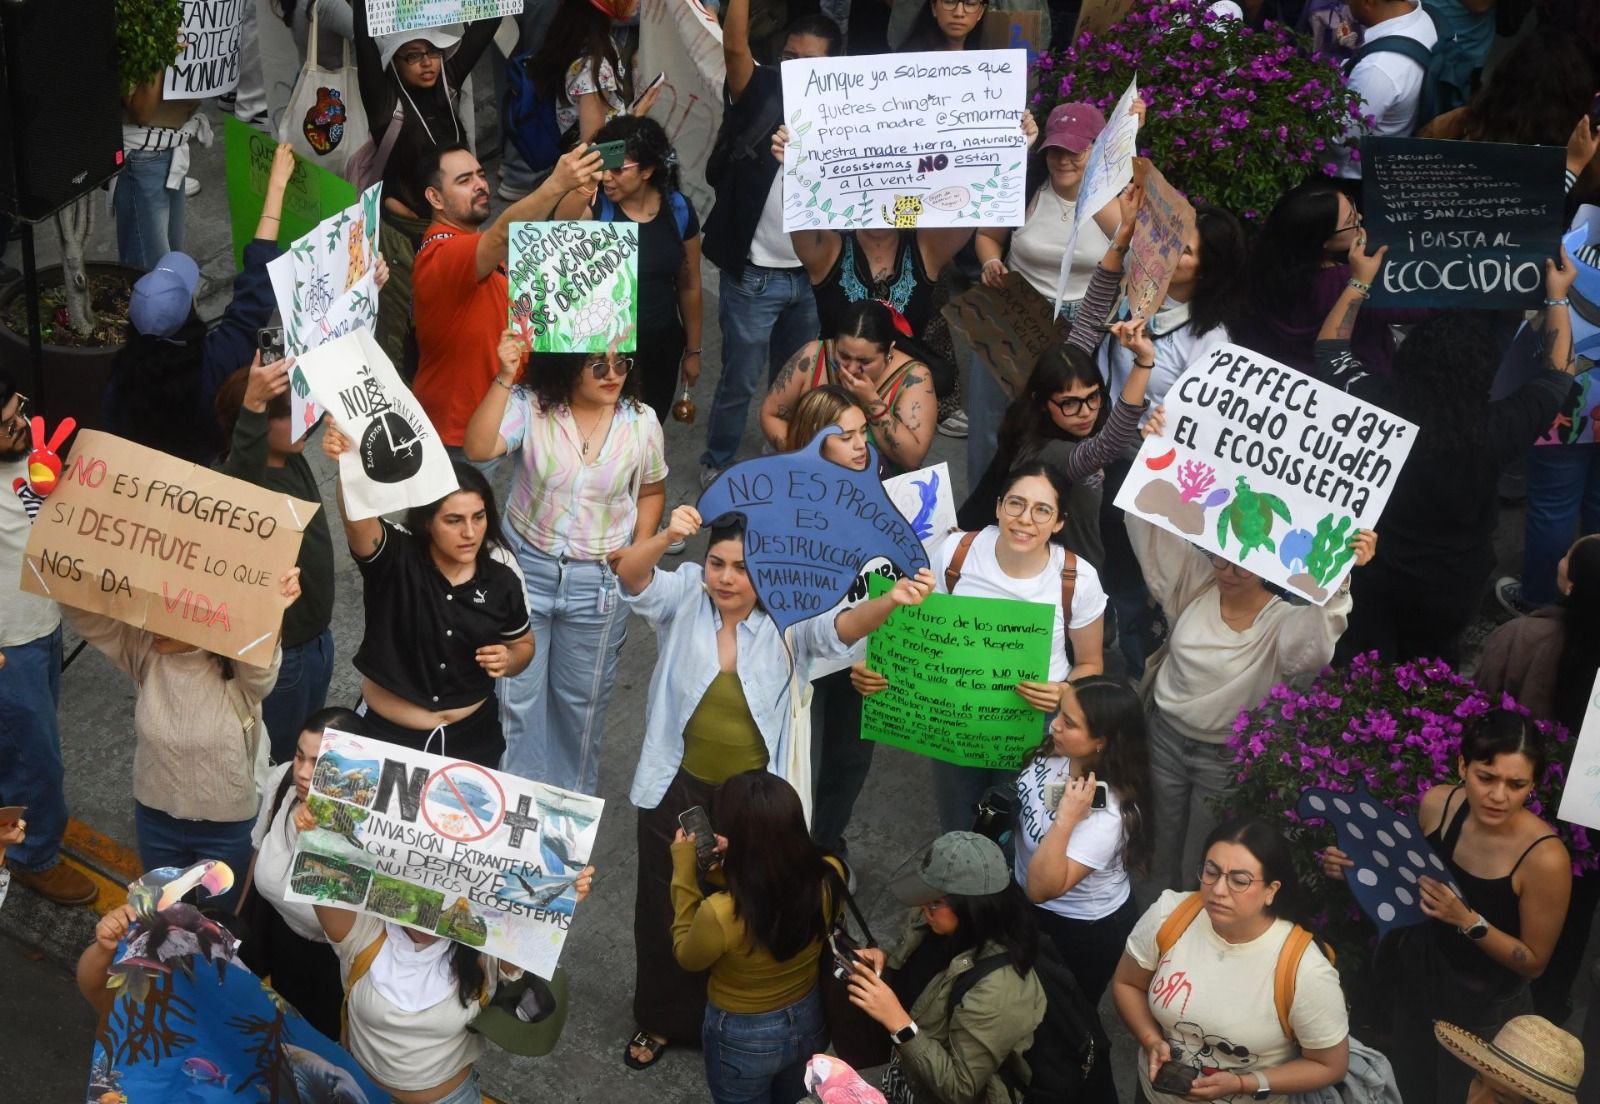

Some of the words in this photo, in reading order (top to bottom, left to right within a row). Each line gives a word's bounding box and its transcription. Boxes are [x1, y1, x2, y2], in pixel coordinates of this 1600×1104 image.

[804, 69, 864, 99] Aunque
[869, 69, 888, 90] ya
[978, 61, 1013, 81] que
[817, 103, 876, 125] quieres
[961, 91, 976, 103] a
[984, 86, 1003, 100] tu
[817, 123, 870, 144] propia
[876, 115, 926, 130] madre
[807, 145, 858, 161] nuestra
[863, 143, 908, 158] madre
[912, 140, 957, 153] tierra,
[819, 163, 826, 179] y
[917, 153, 949, 174] NO
[954, 152, 1000, 165] están
[839, 178, 850, 189] a
[857, 174, 874, 188] la
[880, 173, 926, 187] venta
[509, 221, 587, 291] ARRECIFES
[1492, 231, 1521, 248] AL
[511, 292, 533, 320] NO
[530, 272, 556, 301] SE
[552, 222, 619, 278] VENDEN
[529, 304, 558, 337] SE
[553, 228, 639, 313] DEFIENDEN
[338, 385, 368, 420] NO
[392, 396, 429, 441] FRACKING
[1173, 415, 1200, 450] EL
[67, 453, 108, 489] NO
[112, 473, 140, 499] ES
[144, 479, 278, 541] PROGRESO
[727, 472, 774, 505] NO
[787, 469, 828, 503] ES
[834, 478, 926, 570] PROGRESO
[795, 507, 830, 532] ES
[50, 501, 76, 527] SI
[76, 506, 203, 571] DESTRUYE
[203, 555, 228, 577] LO
[232, 564, 273, 588] QUE
[746, 528, 868, 574] DESTRUCCIÓN
[40, 548, 85, 583] NOS
[100, 567, 133, 599] DA
[161, 581, 232, 633] VIDA
[952, 614, 970, 631] de
[973, 616, 993, 632] los
[992, 668, 1012, 679] NO
[366, 815, 445, 854] INVASIÓN
[365, 840, 399, 861] QUE
[405, 849, 507, 895] DESTRUYE
[375, 858, 463, 894] NUESTROS
[467, 885, 572, 931] ECOSISTEMAS
